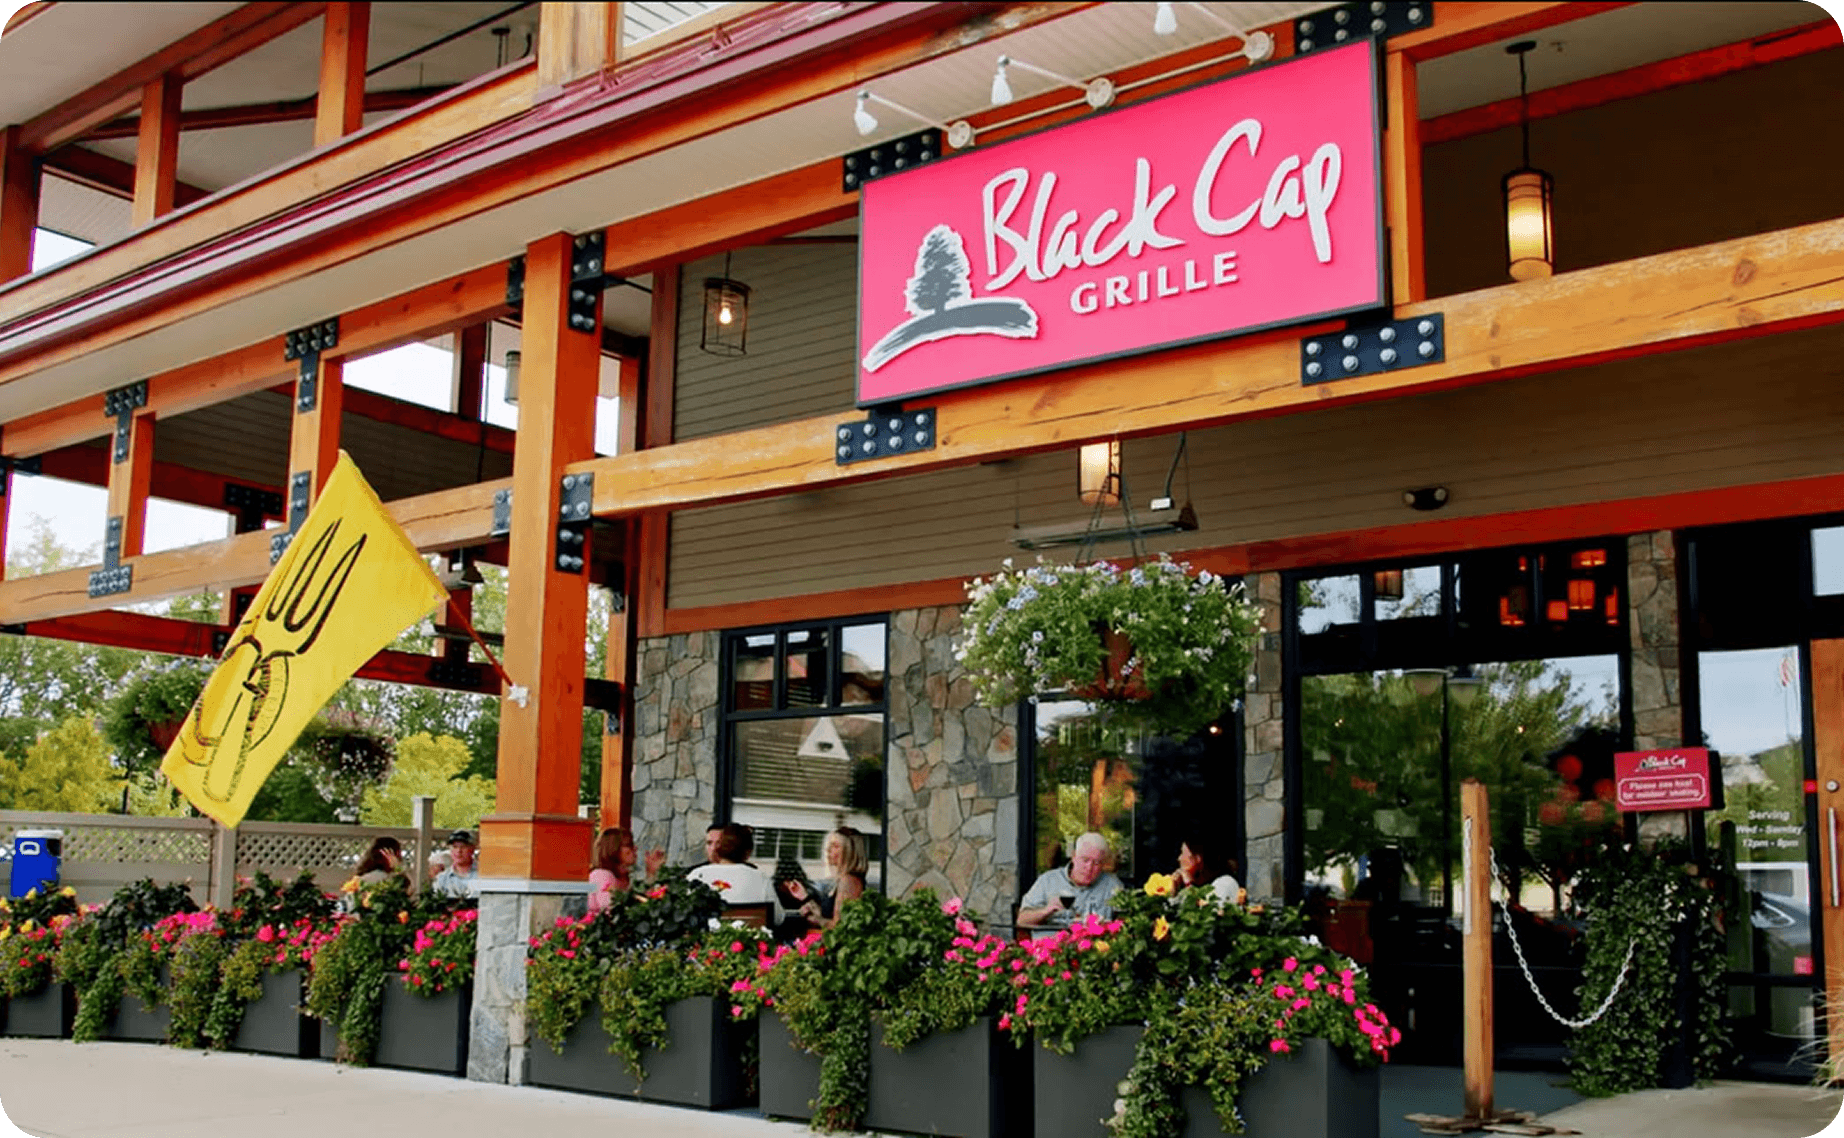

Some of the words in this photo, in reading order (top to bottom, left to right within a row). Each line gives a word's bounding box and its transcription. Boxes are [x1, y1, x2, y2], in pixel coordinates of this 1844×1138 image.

[983, 158, 1186, 291] Black
[1193, 119, 1342, 263] Cap
[1070, 251, 1239, 315] GRILLE
[1735, 825, 1758, 834] Wed
[1765, 824, 1804, 835] Sunday
[1748, 809, 1790, 821] Serving
